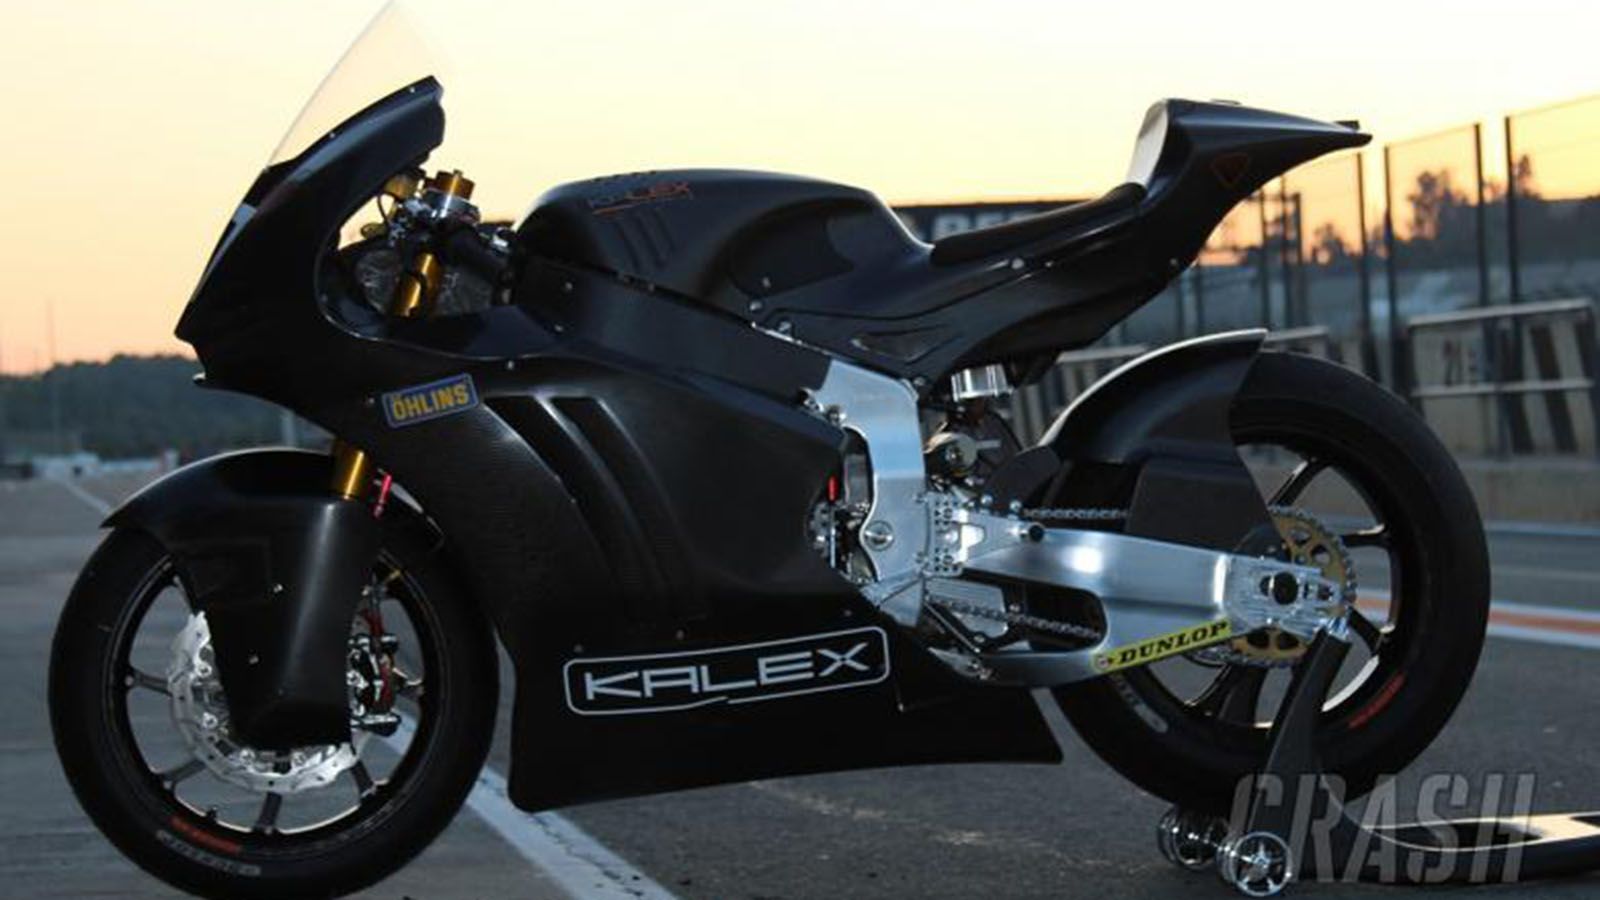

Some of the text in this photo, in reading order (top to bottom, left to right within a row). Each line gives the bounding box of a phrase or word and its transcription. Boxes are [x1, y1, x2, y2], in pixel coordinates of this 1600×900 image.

[393, 384, 469, 420] ÖHLINS
[1118, 620, 1228, 664] DUNLOP
[584, 642, 869, 700] KALEX
